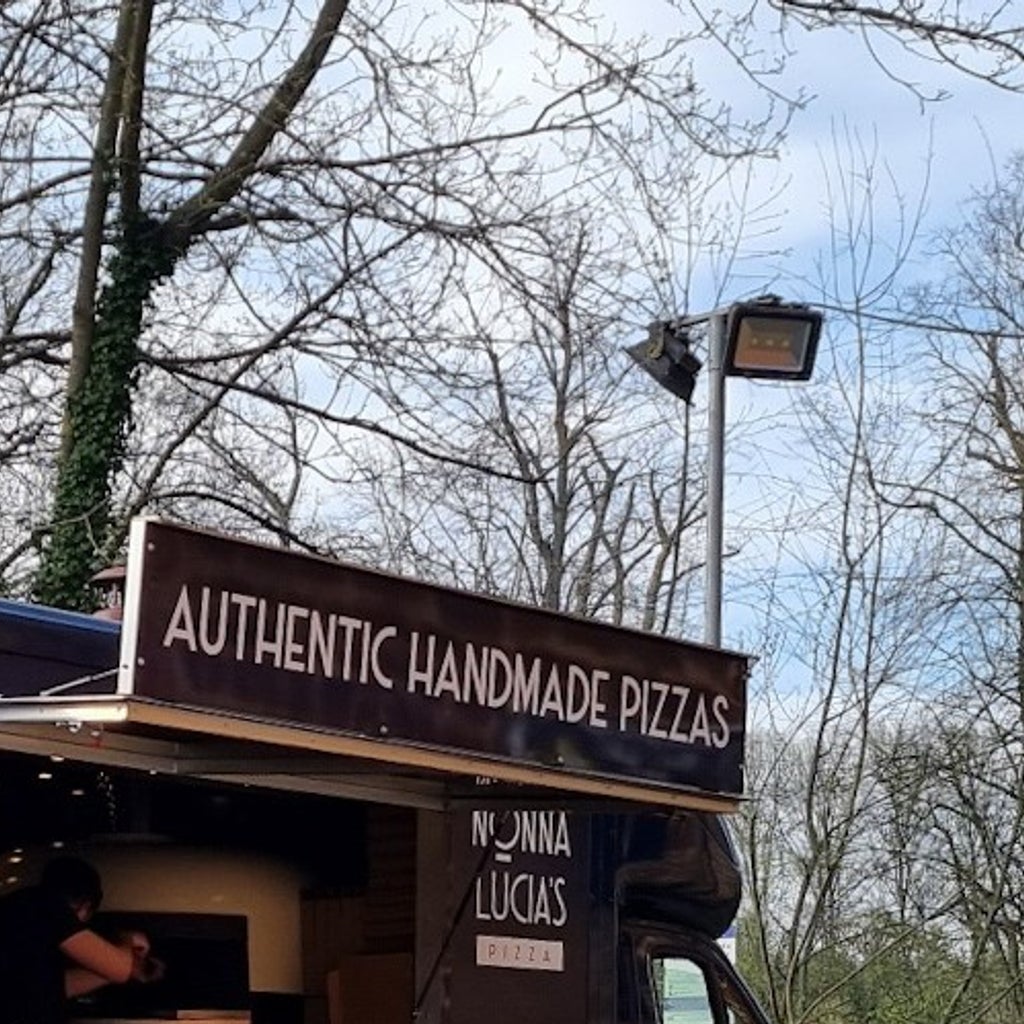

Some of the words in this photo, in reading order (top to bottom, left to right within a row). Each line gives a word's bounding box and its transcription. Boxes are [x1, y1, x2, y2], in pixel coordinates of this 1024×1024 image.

[162, 583, 398, 690] AUTHENTIC
[407, 631, 611, 729] HANDMADE
[619, 675, 730, 749] PIZZAS
[472, 810, 572, 857] NONNA
[476, 870, 568, 927] LUCIA'S
[487, 943, 551, 962] PIZZA
